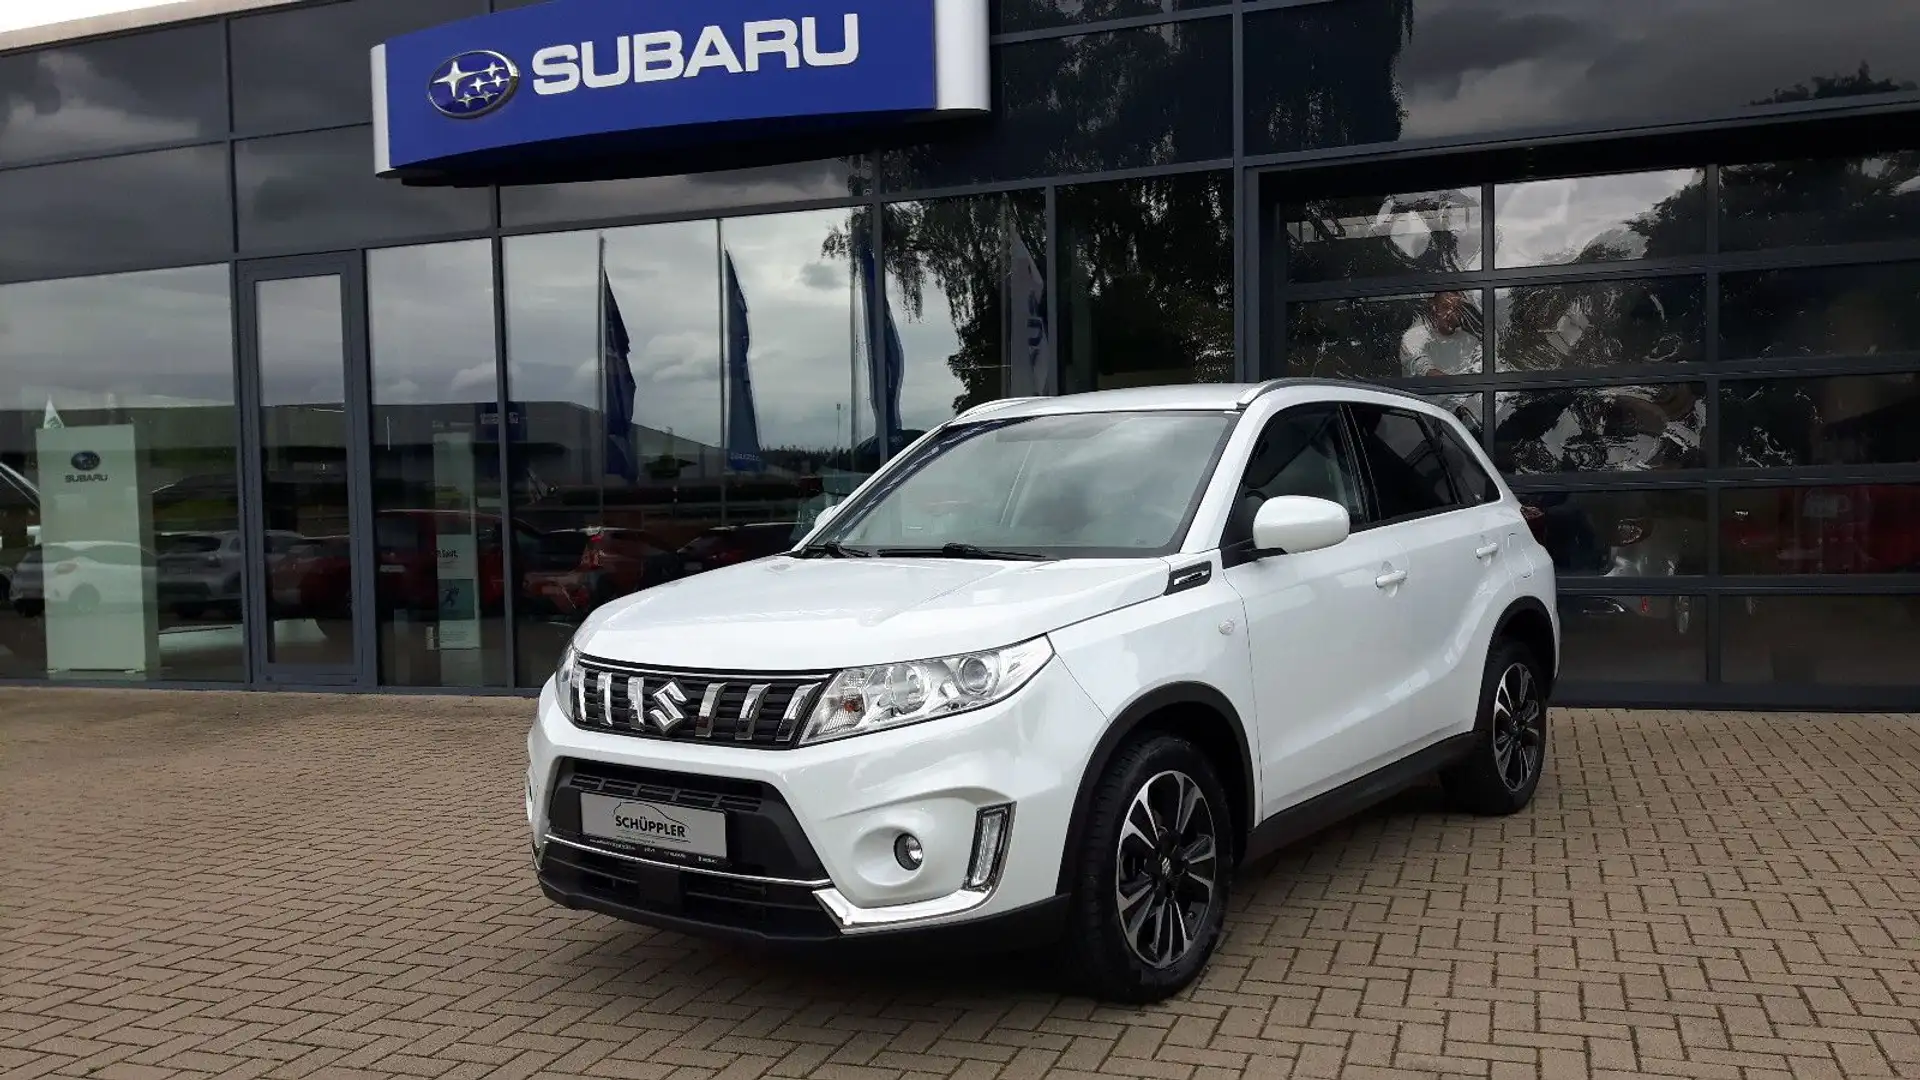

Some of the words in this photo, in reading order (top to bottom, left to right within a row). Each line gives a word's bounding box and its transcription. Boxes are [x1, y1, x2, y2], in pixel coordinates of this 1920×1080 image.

[532, 13, 859, 95] SUBARU
[65, 473, 108, 484] SUBARU
[615, 814, 686, 838] SCHÜPPLER
